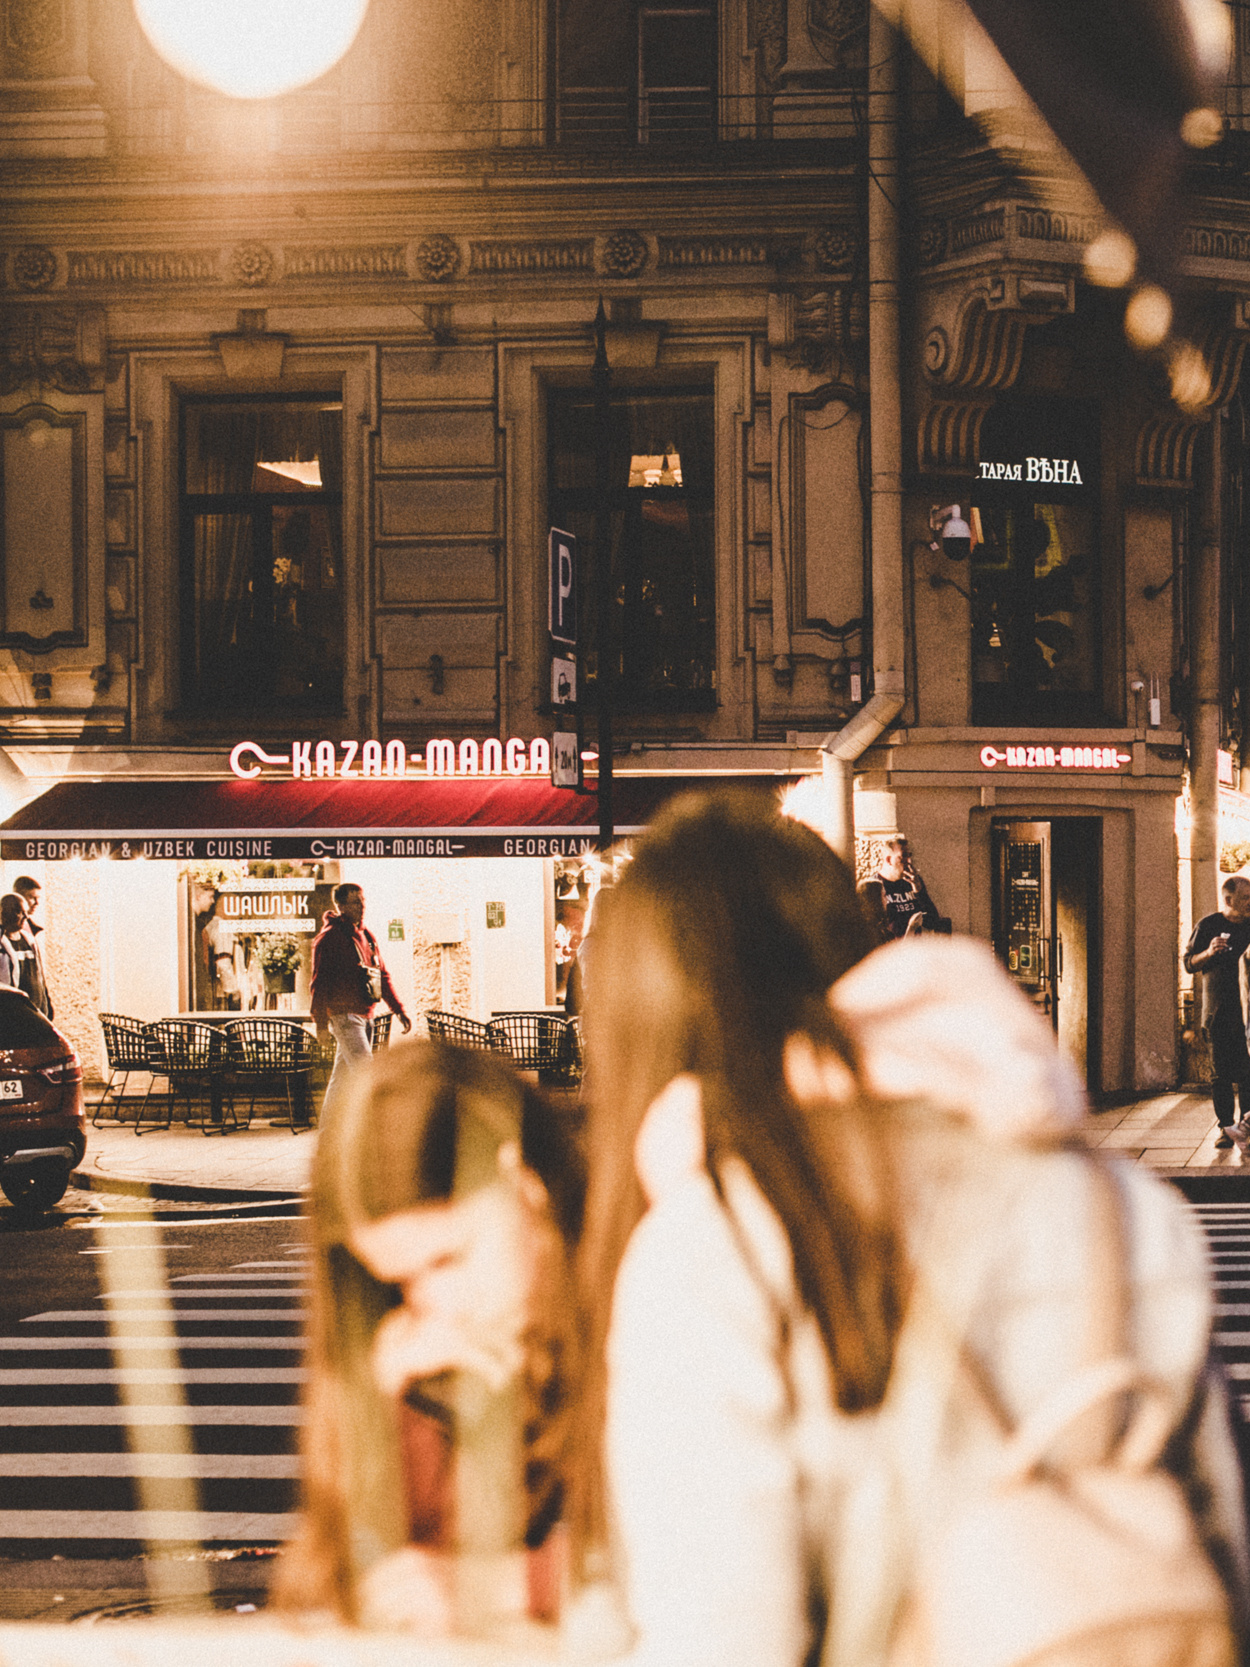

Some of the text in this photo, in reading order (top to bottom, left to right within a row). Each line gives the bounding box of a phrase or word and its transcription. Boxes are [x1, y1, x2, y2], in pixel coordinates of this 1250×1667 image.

[975, 461, 1022, 481] ТАРАЯ
[292, 737, 551, 779] KAZAN-MANGA
[25, 840, 273, 859] GEORGIAN & UZBEK CUISINE
[503, 838, 591, 856] GEORGIAN
[223, 894, 309, 916] ШАШЛЫК
[4, 1081, 18, 1093] 62
